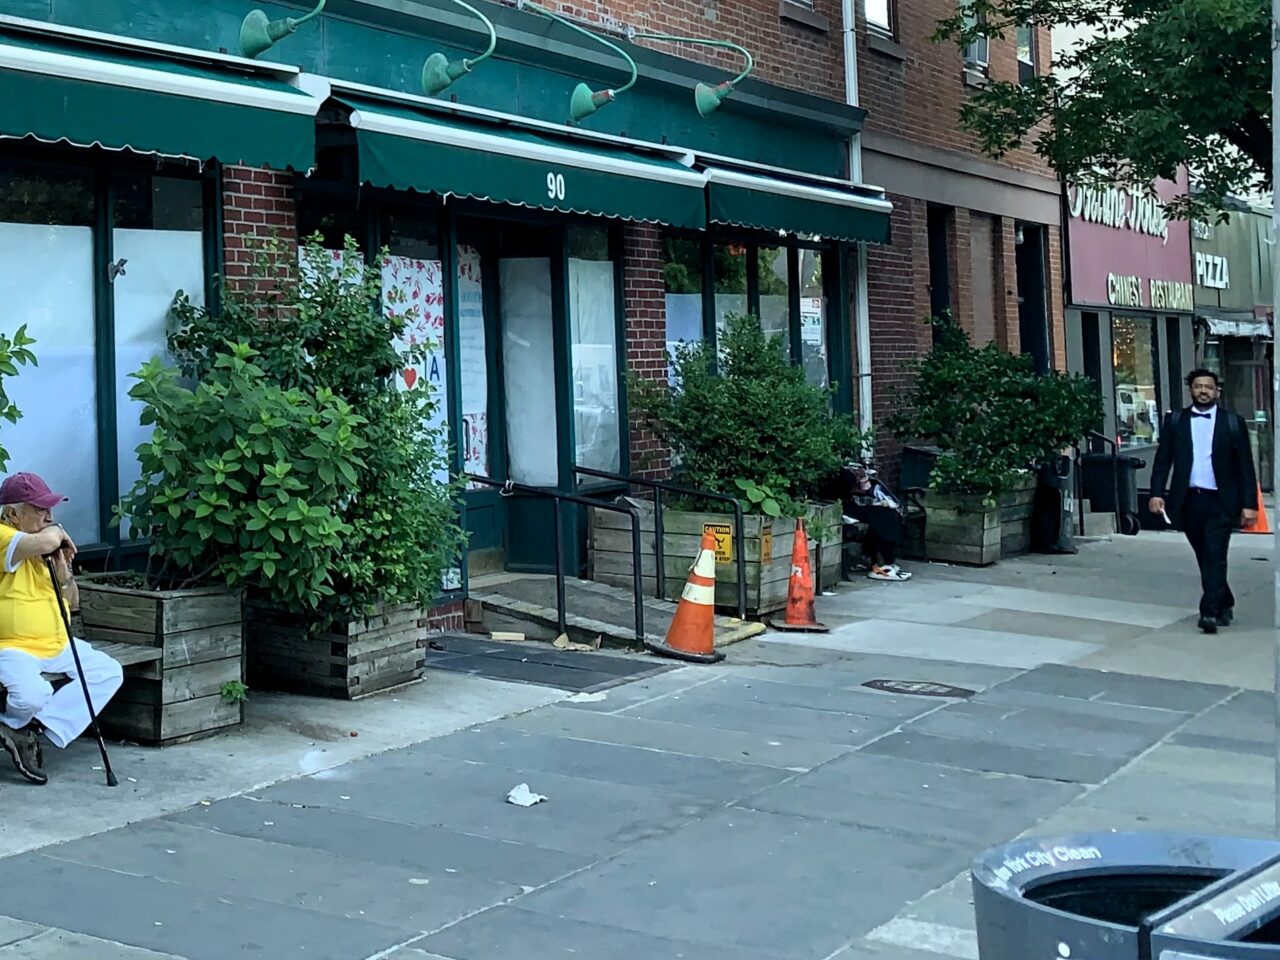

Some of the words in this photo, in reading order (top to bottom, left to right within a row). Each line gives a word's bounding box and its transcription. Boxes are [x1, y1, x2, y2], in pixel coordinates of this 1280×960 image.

[547, 172, 565, 200] 90
[1195, 251, 1230, 289] PIZZA
[1107, 272, 1143, 307] CHINESE
[1149, 278, 1194, 311] RESTAURANT
[429, 355, 440, 381] A
[1025, 851, 1056, 867] City
[1053, 846, 1102, 861] Clean
[1213, 903, 1246, 925] Please
